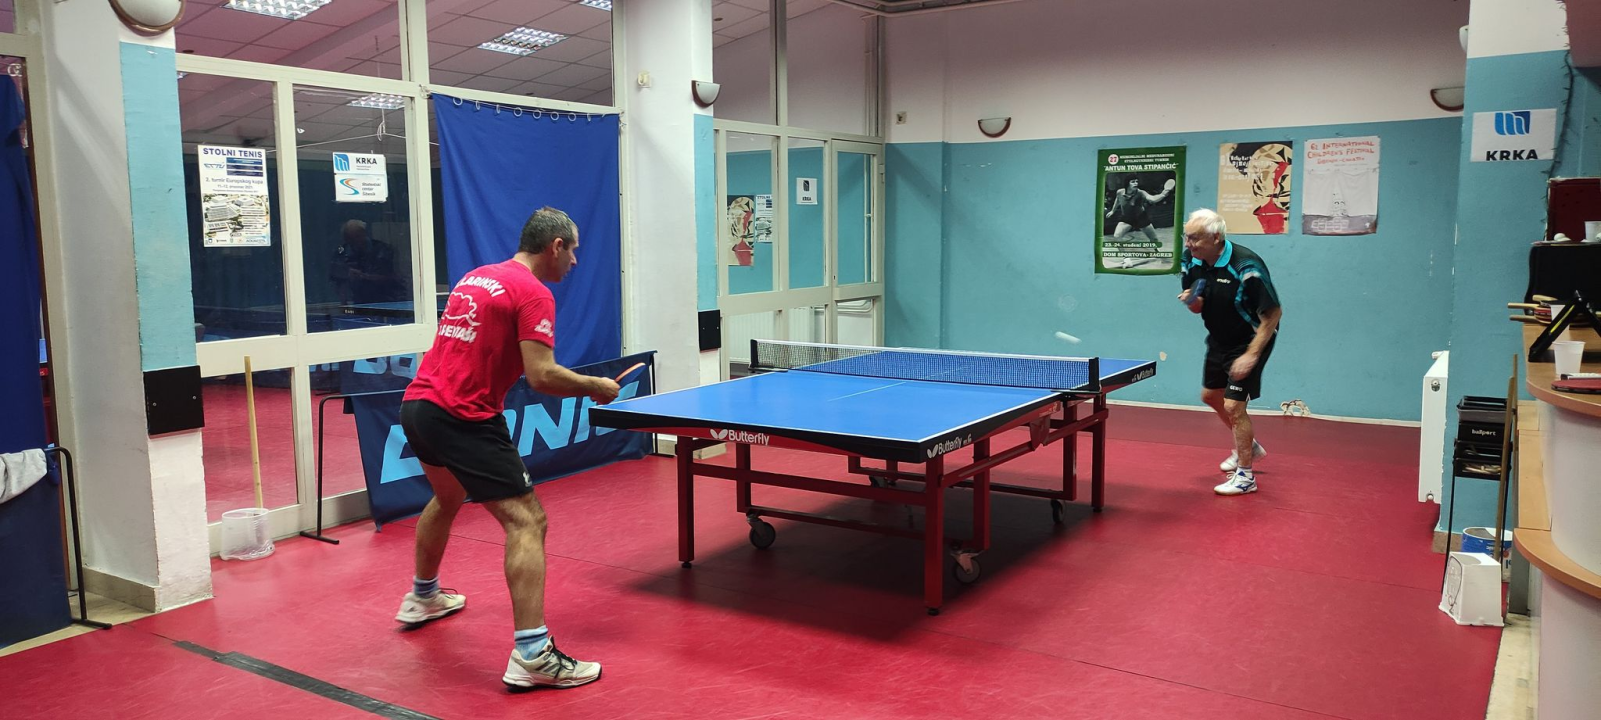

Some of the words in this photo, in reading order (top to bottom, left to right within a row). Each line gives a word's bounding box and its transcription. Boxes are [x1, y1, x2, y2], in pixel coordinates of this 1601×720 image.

[1322, 140, 1374, 150] INTERNATIONAL
[203, 148, 236, 157] STOLNI
[238, 150, 263, 158] TENIS
[1485, 149, 1539, 161] KRKA
[355, 157, 378, 165] KRKA
[728, 429, 770, 446] Butterfly
[938, 437, 962, 455] Butterfly
